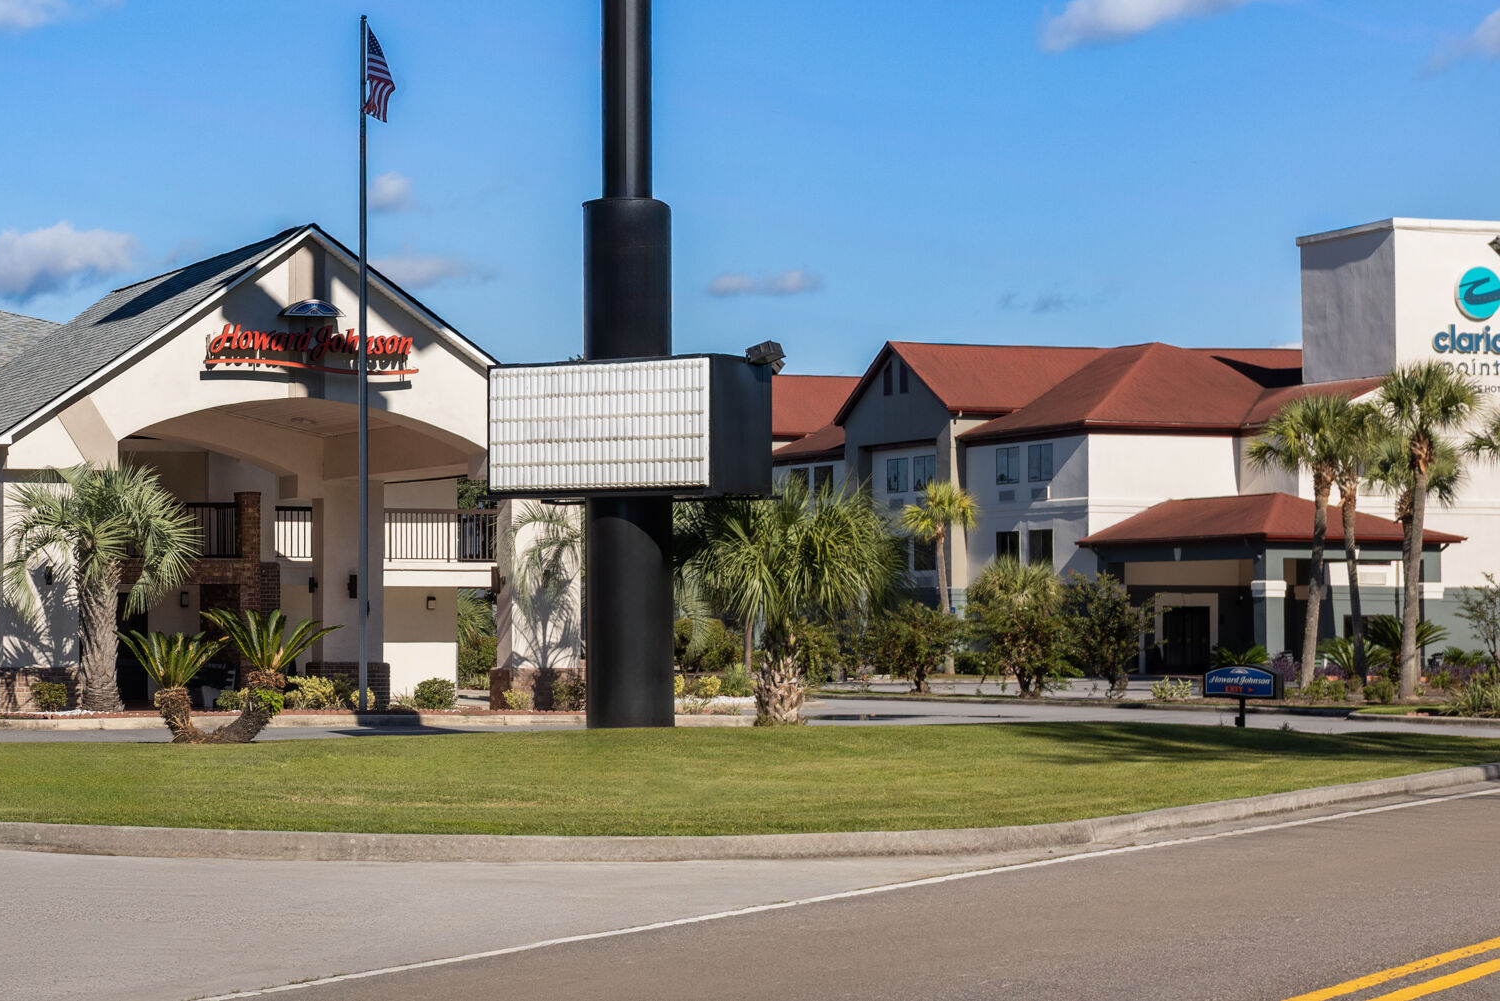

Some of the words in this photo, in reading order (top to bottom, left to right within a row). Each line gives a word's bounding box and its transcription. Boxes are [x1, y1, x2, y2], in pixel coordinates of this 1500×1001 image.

[210, 323, 314, 353] Howard
[311, 325, 414, 362] Johnson
[1209, 676, 1240, 684] Howard
[1239, 676, 1270, 685] Johnson
